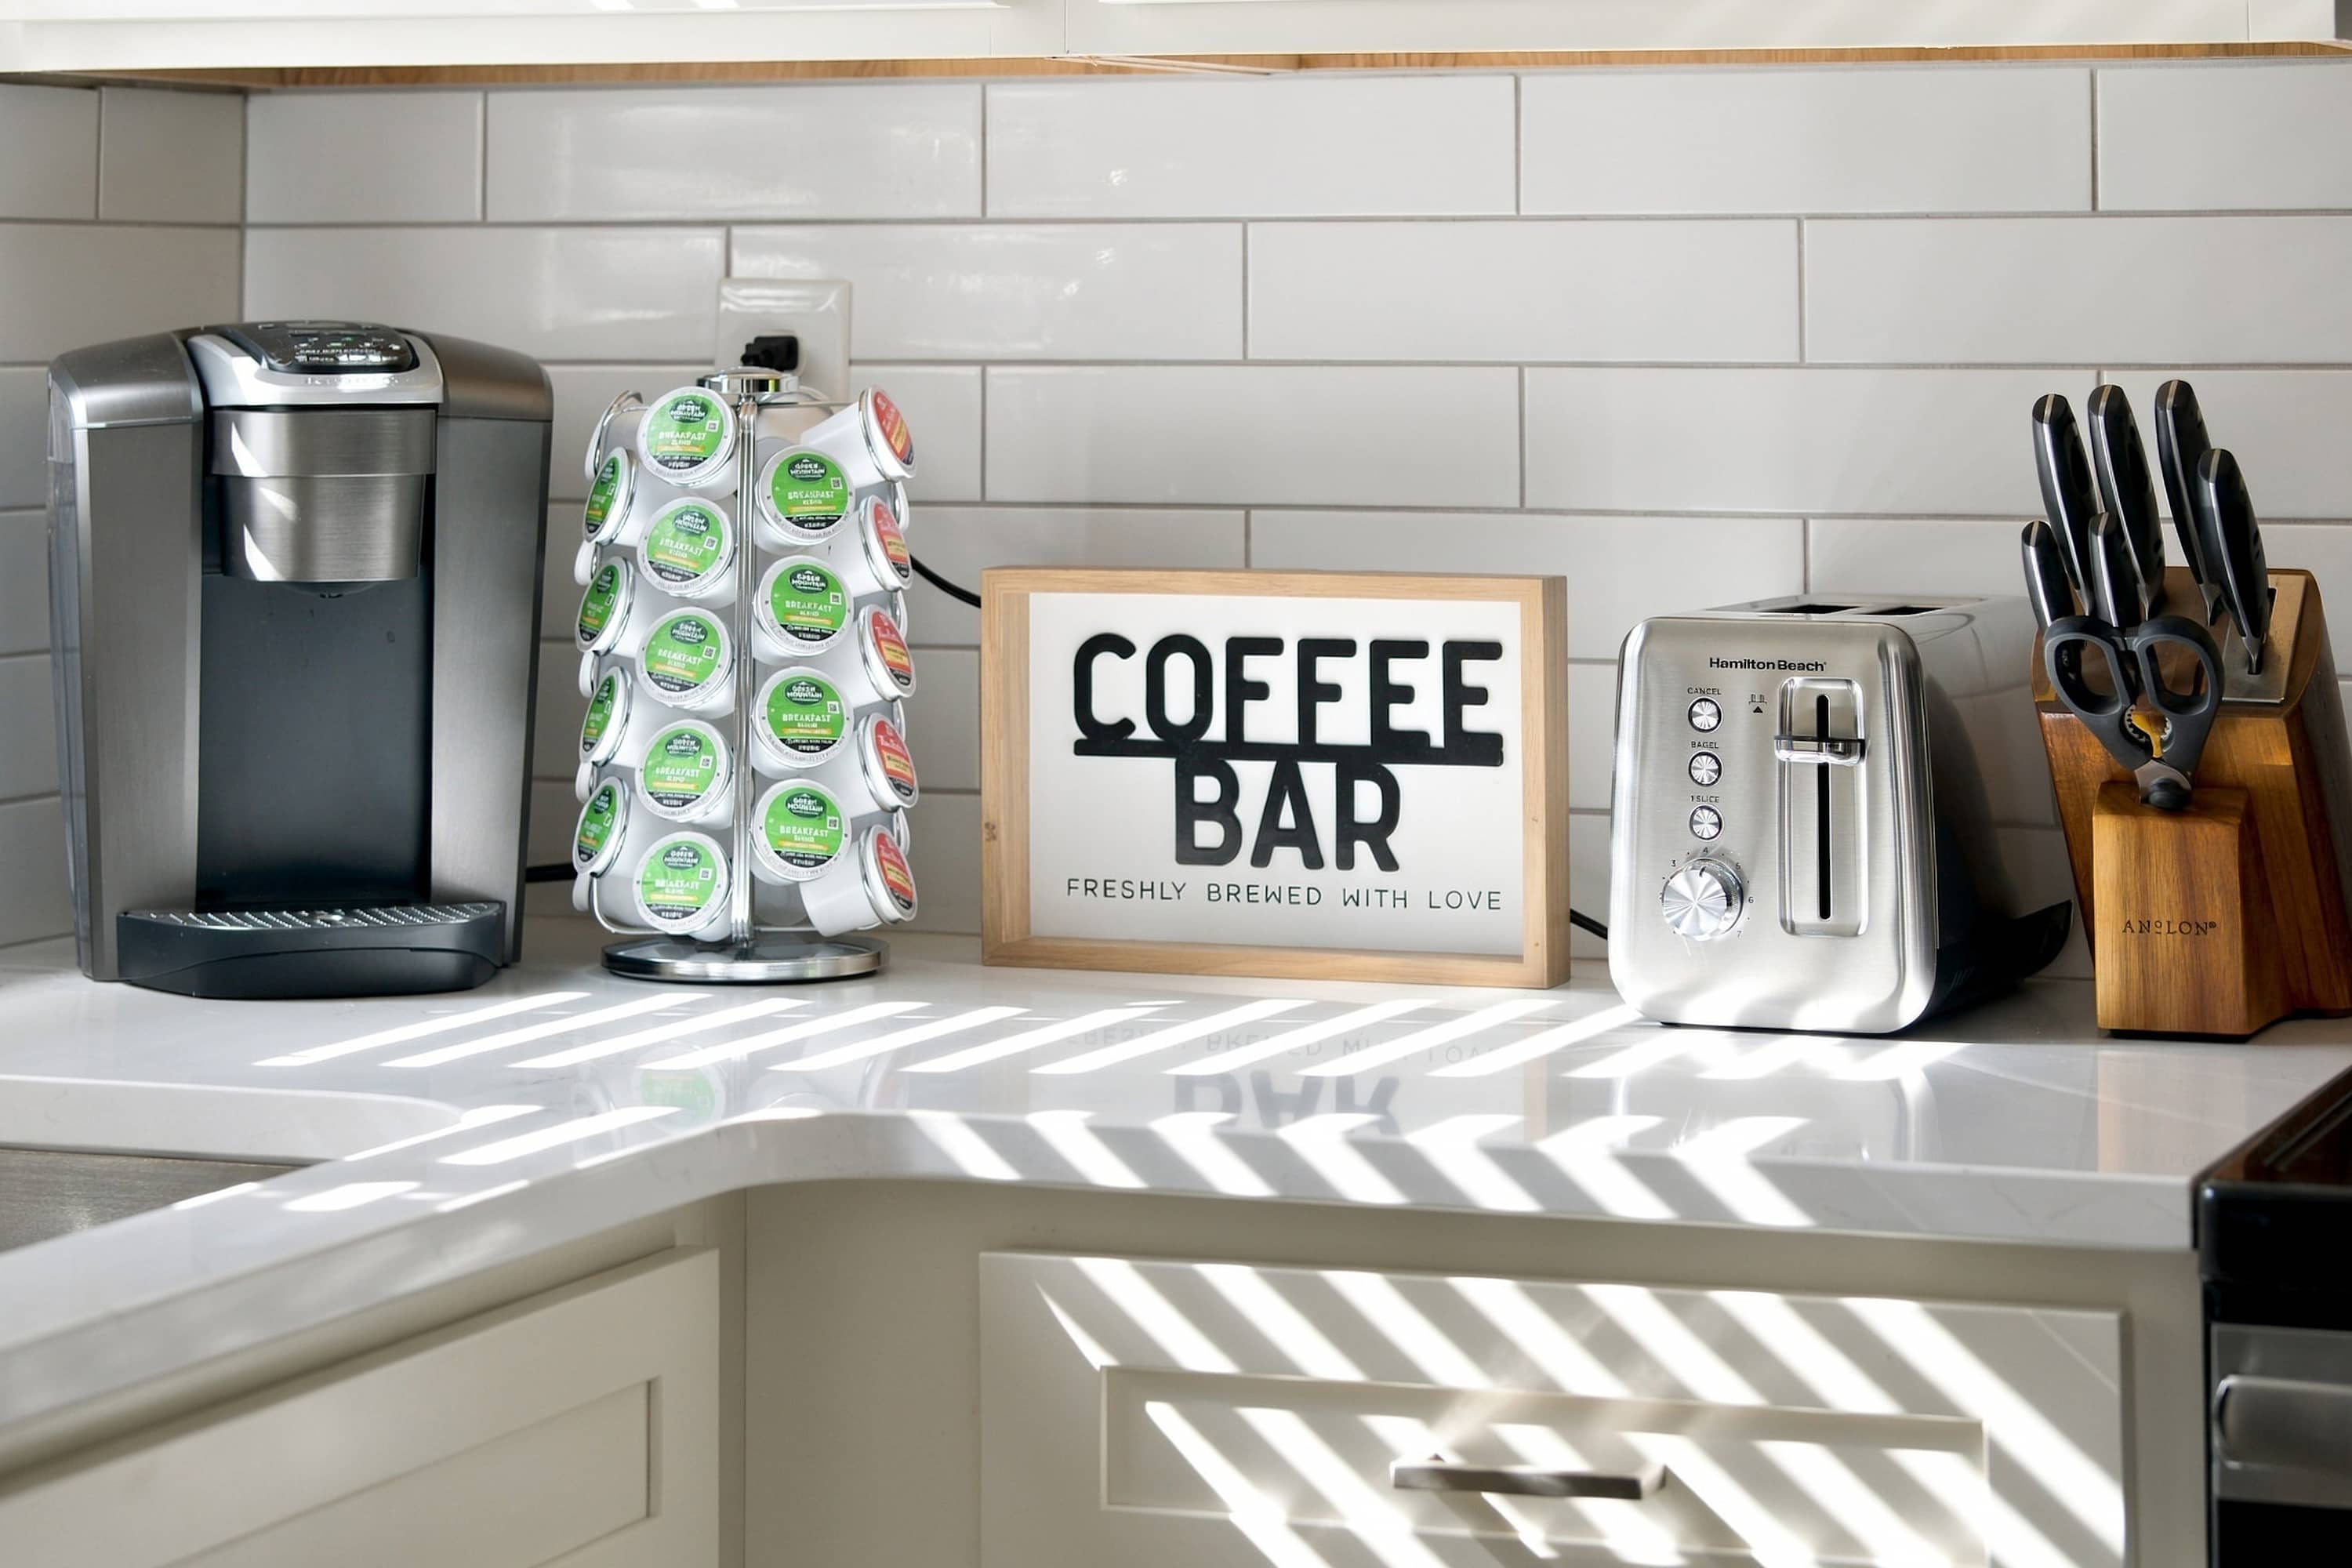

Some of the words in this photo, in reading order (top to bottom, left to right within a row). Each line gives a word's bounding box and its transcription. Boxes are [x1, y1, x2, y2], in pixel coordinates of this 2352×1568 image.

[659, 431, 706, 441] BREAKFAST
[788, 491, 835, 499] BREAKFAST
[659, 538, 703, 556] BREAKFAST
[792, 579, 826, 588] MOUNTAIN
[786, 601, 832, 612] BREAKFAST
[658, 648, 702, 665] BREAKFAST
[1709, 658, 1775, 670] Hamilton
[1073, 633, 1504, 754] COFFEE
[782, 713, 831, 722] BREAKFAST
[655, 767, 700, 778] BREAKFAST
[1175, 757, 1400, 872] BAR
[780, 826, 829, 837] BREAKFAST
[655, 879, 699, 890] BREAKFAST
[1067, 878, 1187, 901] FRESHLY
[1207, 884, 1322, 906] BREWED
[1343, 888, 1409, 909] WITH
[1428, 890, 1503, 910] LOVE
